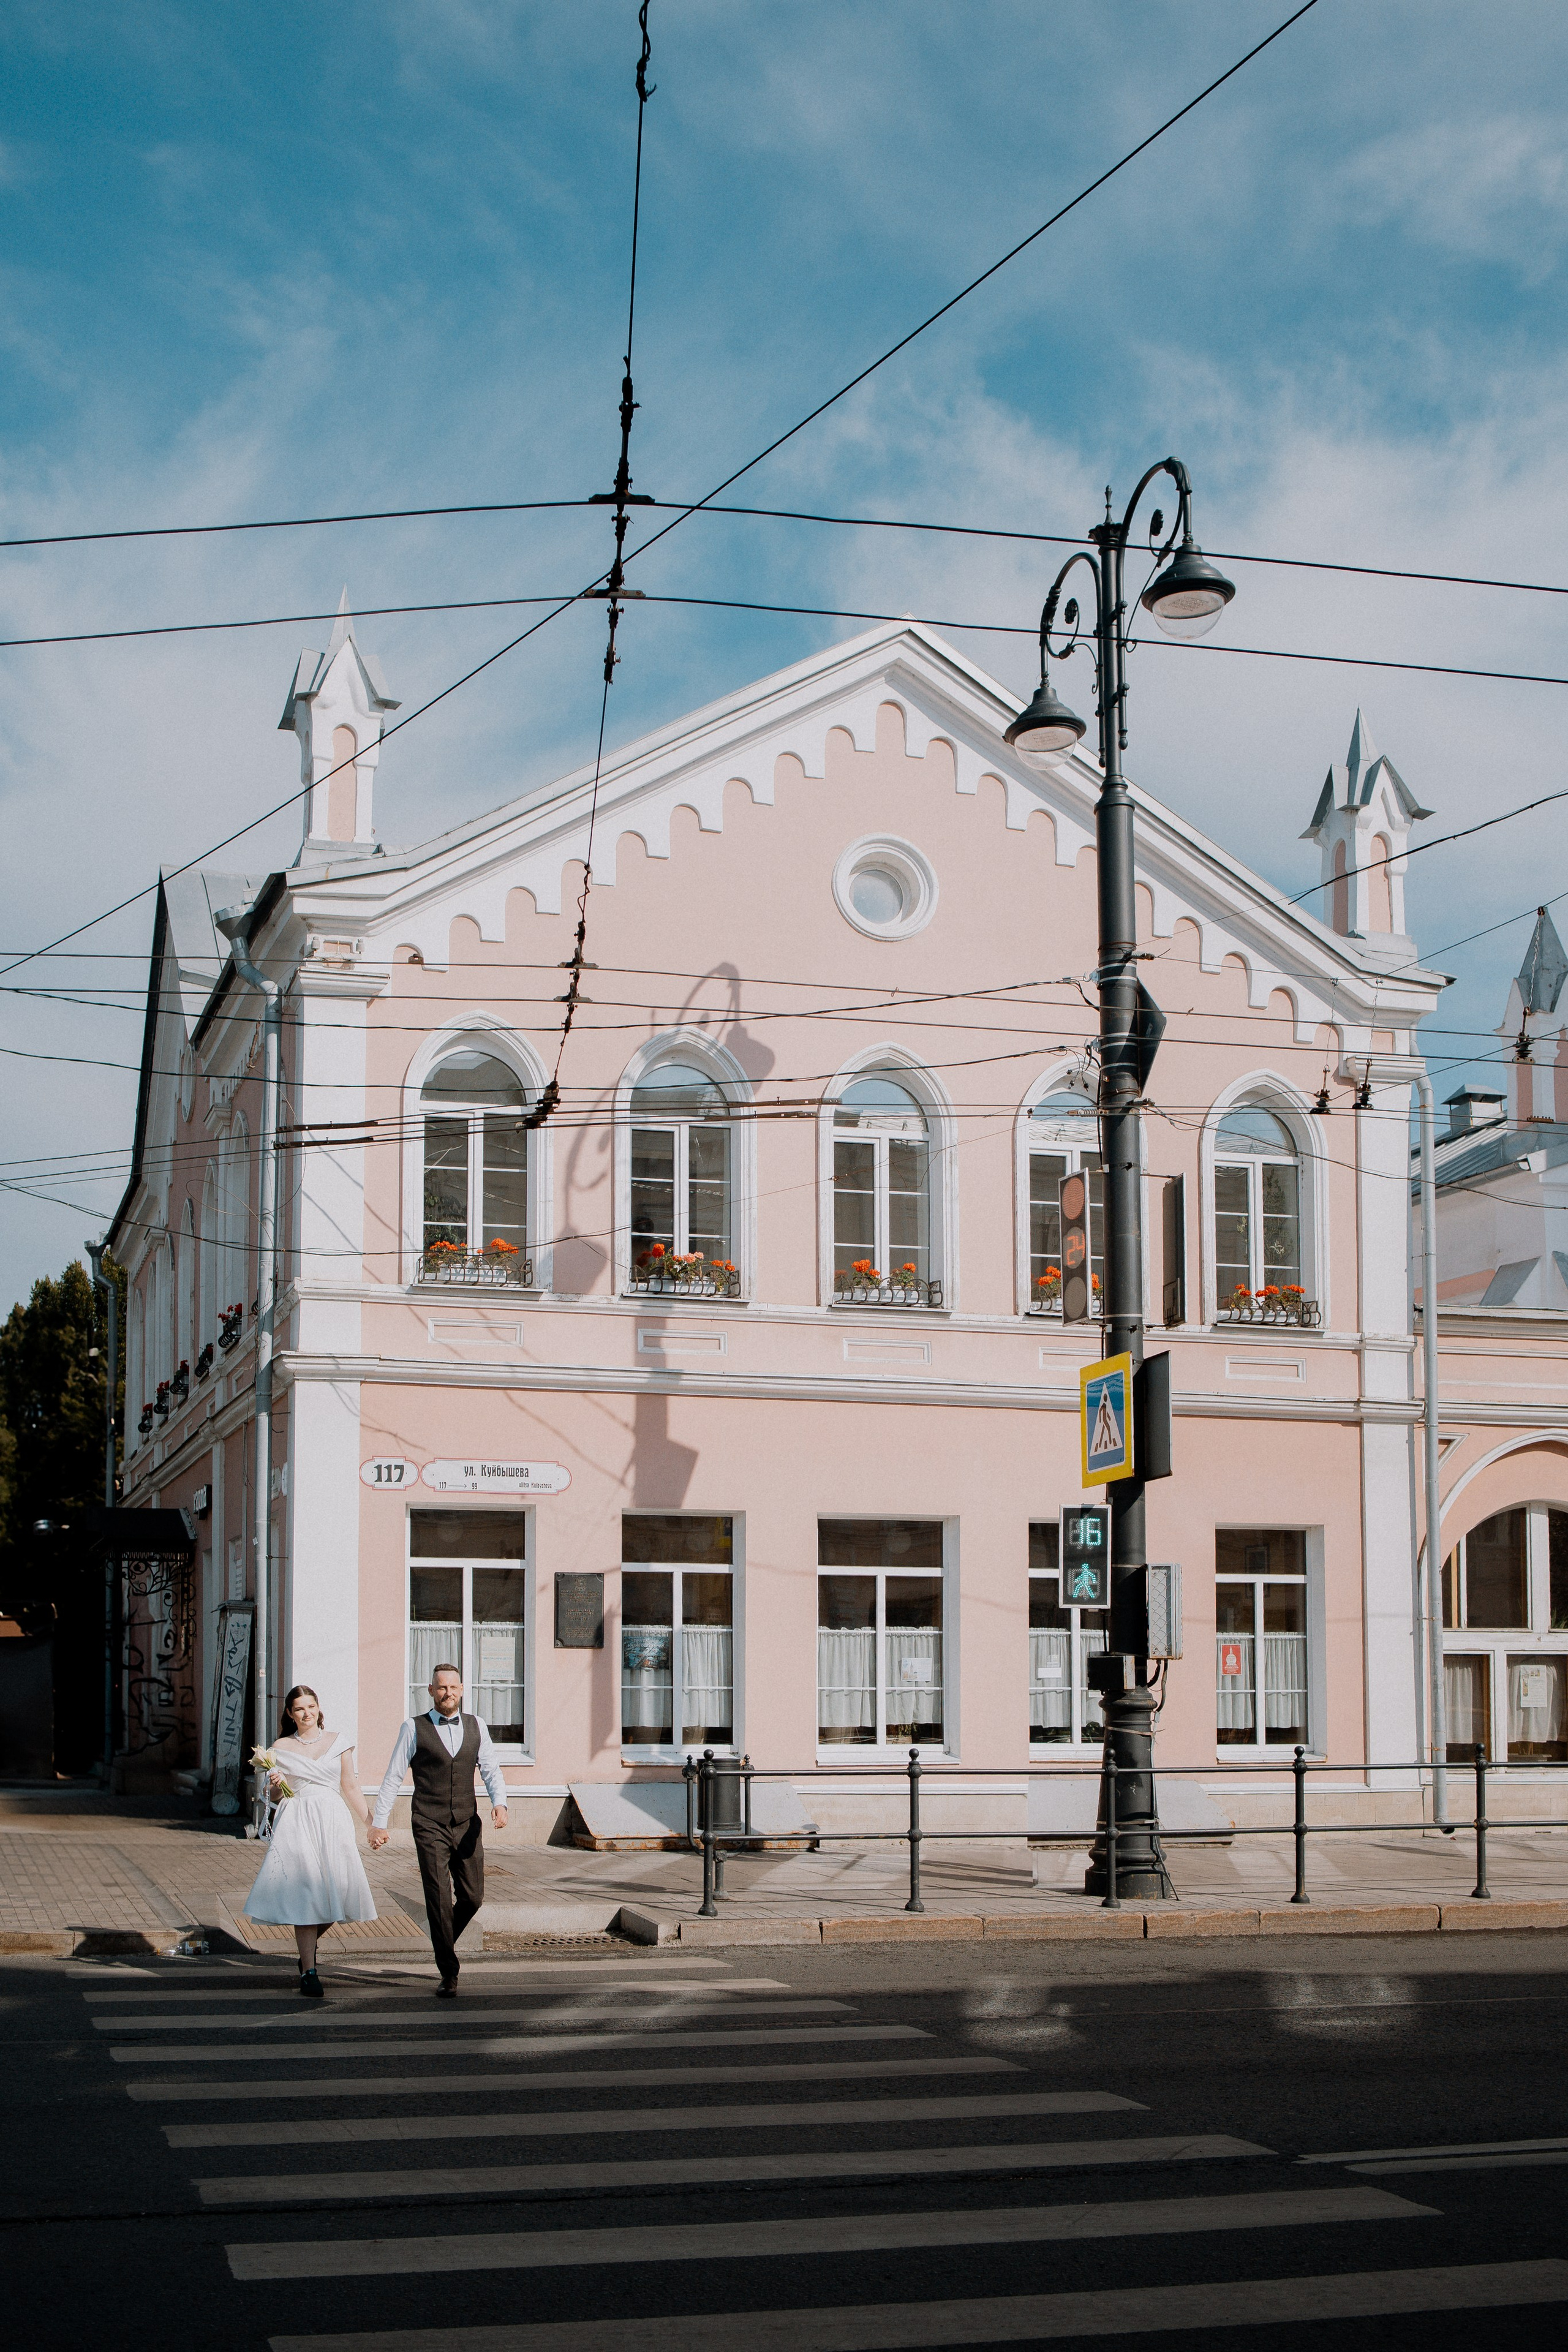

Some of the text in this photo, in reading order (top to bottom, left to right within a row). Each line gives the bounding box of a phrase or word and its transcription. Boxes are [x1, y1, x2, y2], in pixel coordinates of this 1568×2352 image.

[1067, 1233, 1085, 1265] 24
[374, 1464, 404, 1482] 117
[464, 1464, 529, 1477] ул. Куйбышева
